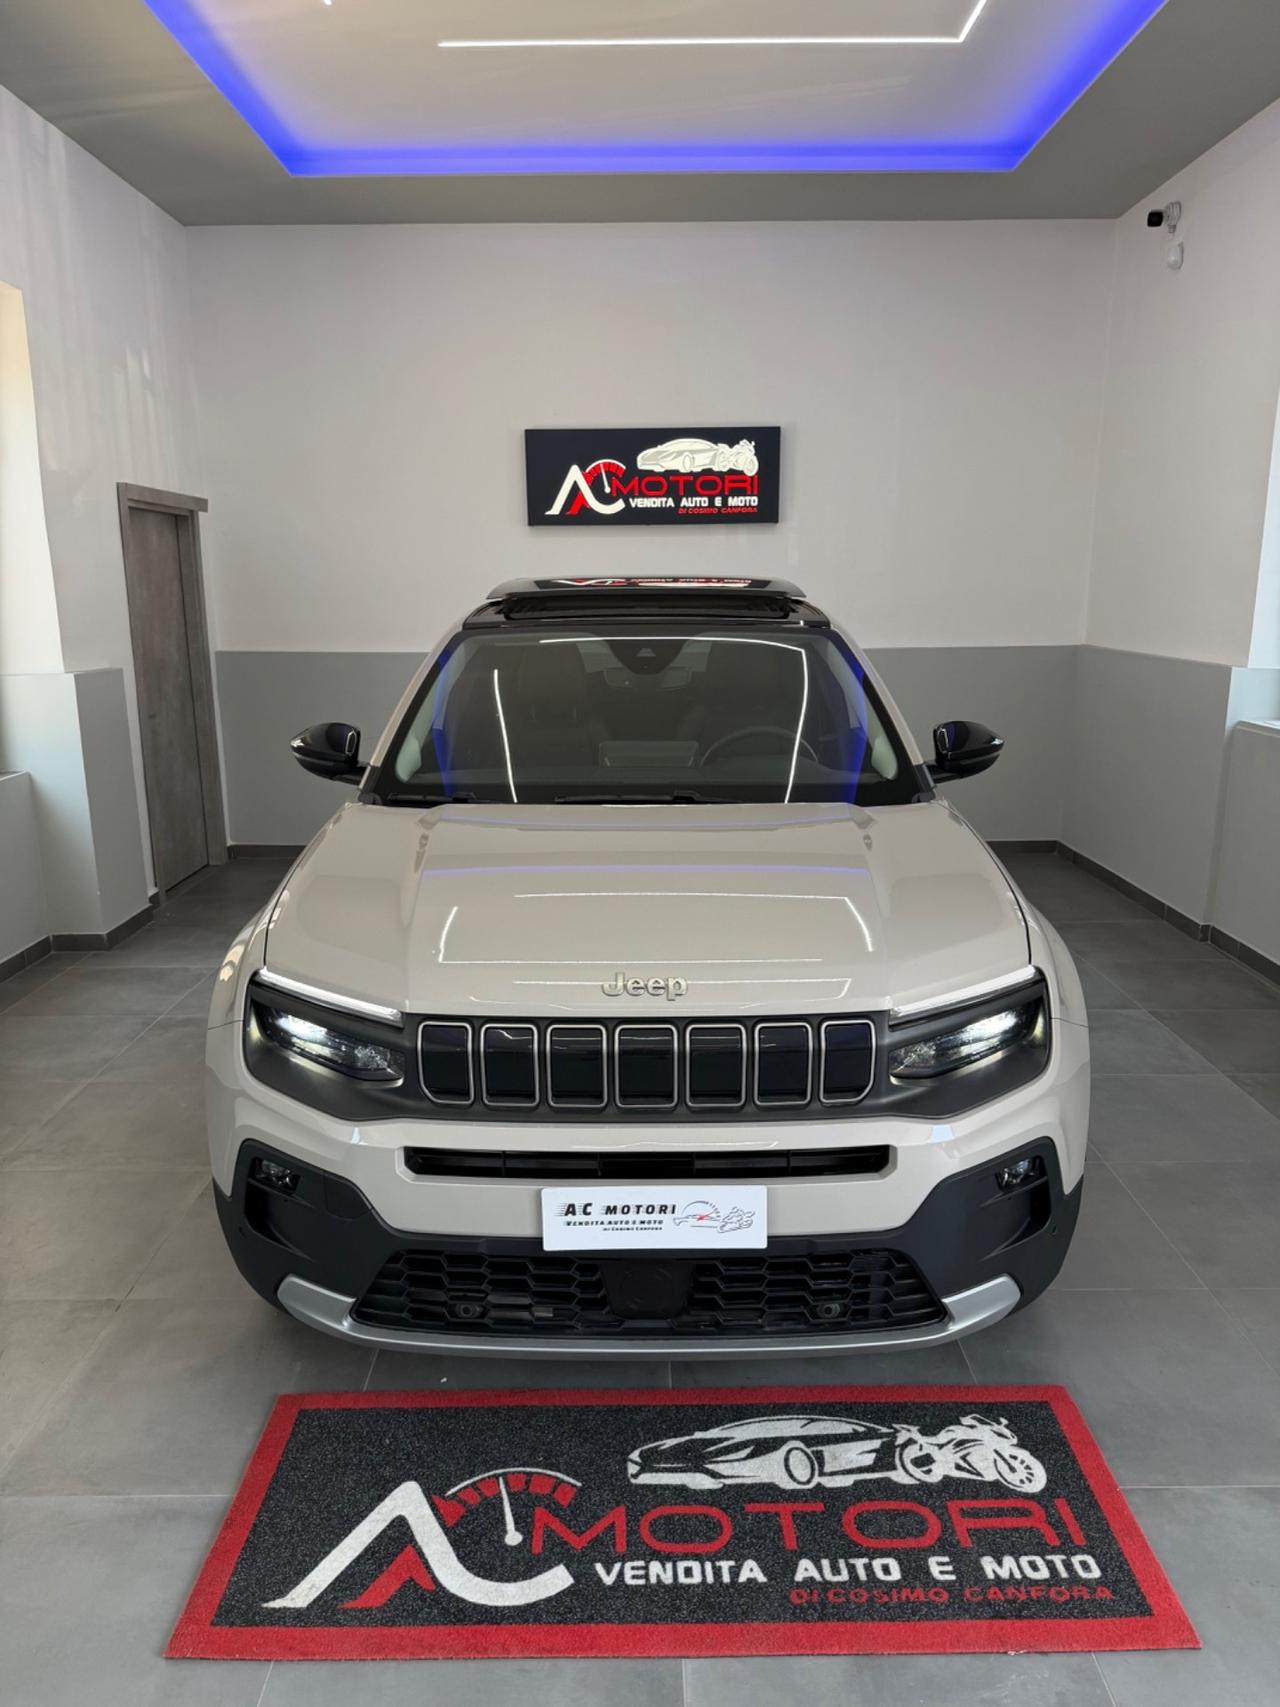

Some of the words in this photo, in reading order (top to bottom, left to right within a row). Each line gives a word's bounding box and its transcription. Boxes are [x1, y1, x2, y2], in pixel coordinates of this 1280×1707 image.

[611, 475, 759, 497] MOTORI
[629, 497, 675, 508] VENDITA
[680, 496, 709, 507] AUTO
[714, 496, 722, 507] E
[727, 496, 758, 507] MOTO
[602, 972, 688, 1001] Jeep
[604, 1204, 677, 1215] MOTORI
[531, 1498, 1087, 1556] MOTORI
[595, 1559, 768, 1586] VENDITA
[794, 1557, 902, 1582] AUTO
[928, 1556, 957, 1581] E
[979, 1554, 1102, 1580] MOTO
[789, 1588, 820, 1606] DI
[827, 1586, 949, 1605] COSIMO
[963, 1585, 1115, 1602] CANFORA
